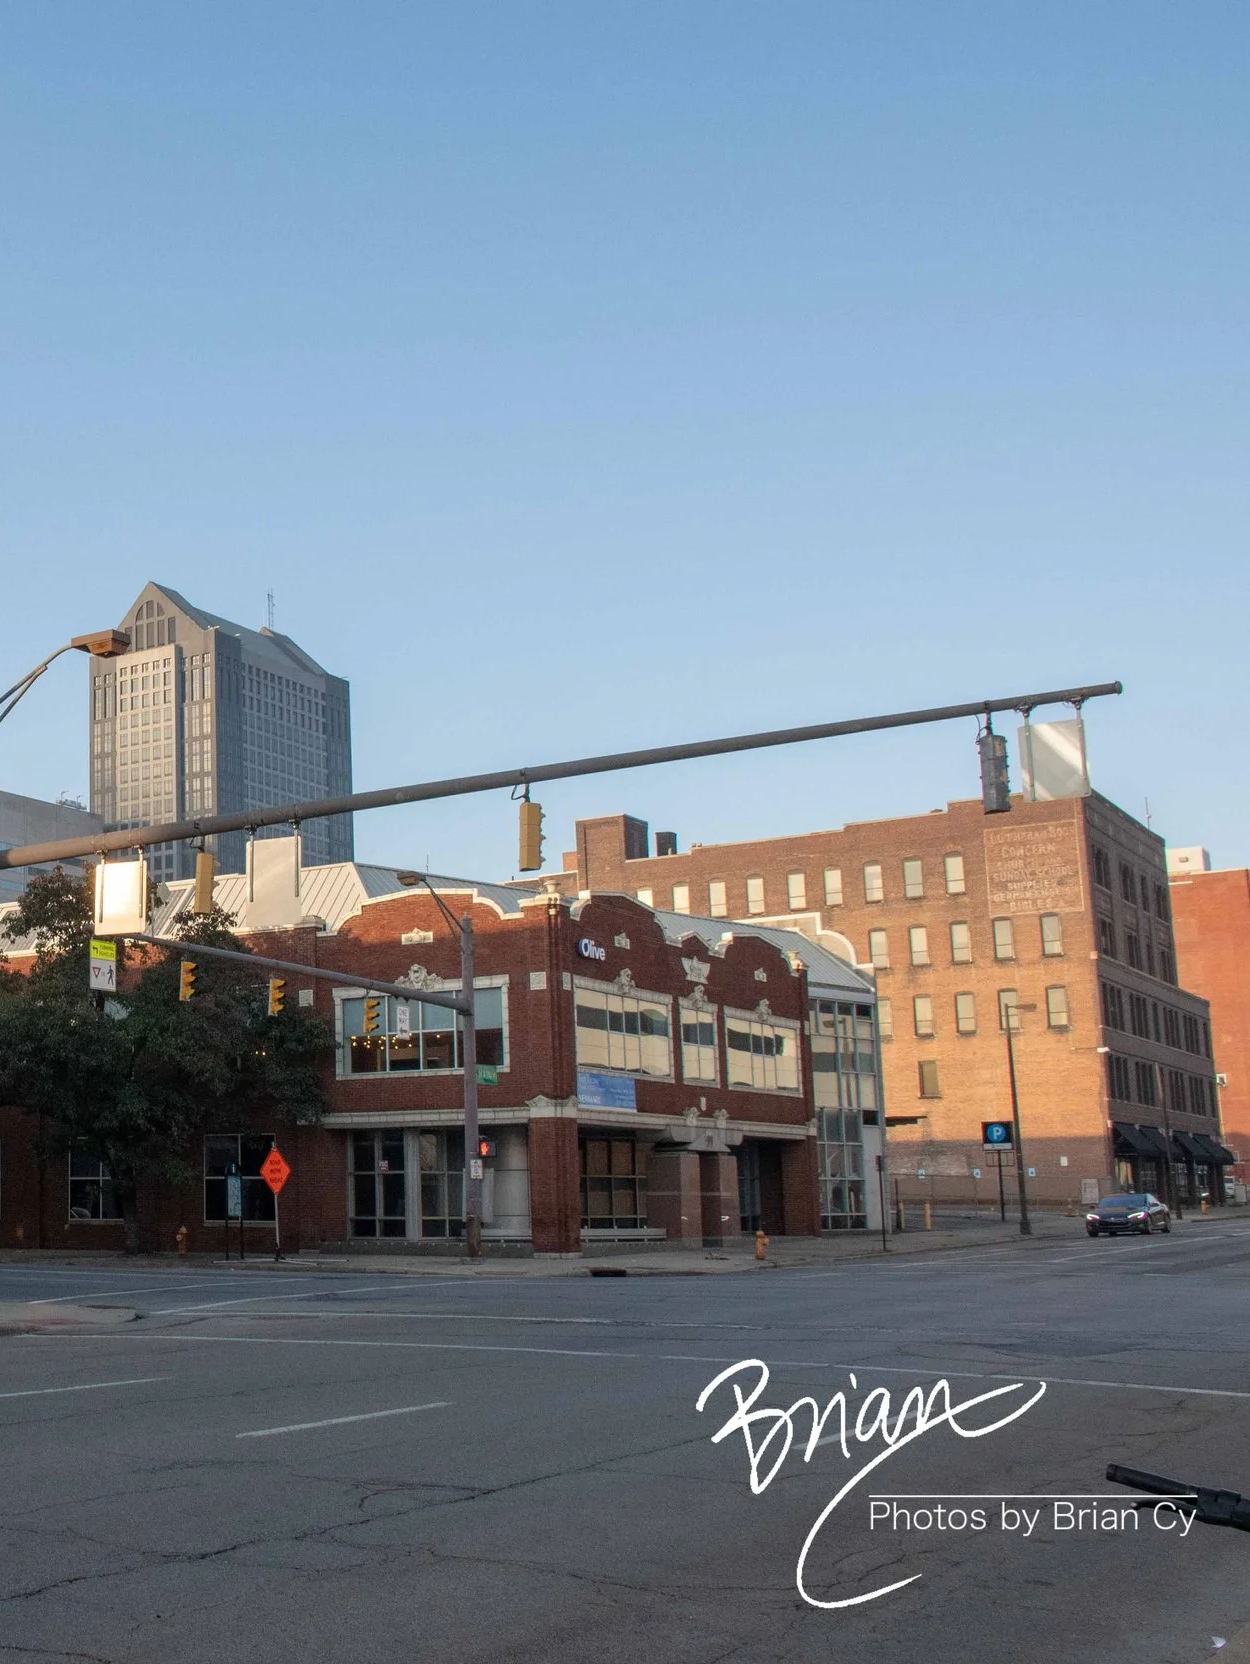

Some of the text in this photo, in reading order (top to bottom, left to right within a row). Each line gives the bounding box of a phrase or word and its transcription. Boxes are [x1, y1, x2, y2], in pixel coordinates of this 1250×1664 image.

[1001, 842, 1055, 858] CONCERN
[1007, 879, 1054, 891] SUPPLIE
[580, 938, 606, 961] Olive
[993, 1126, 1002, 1140] P
